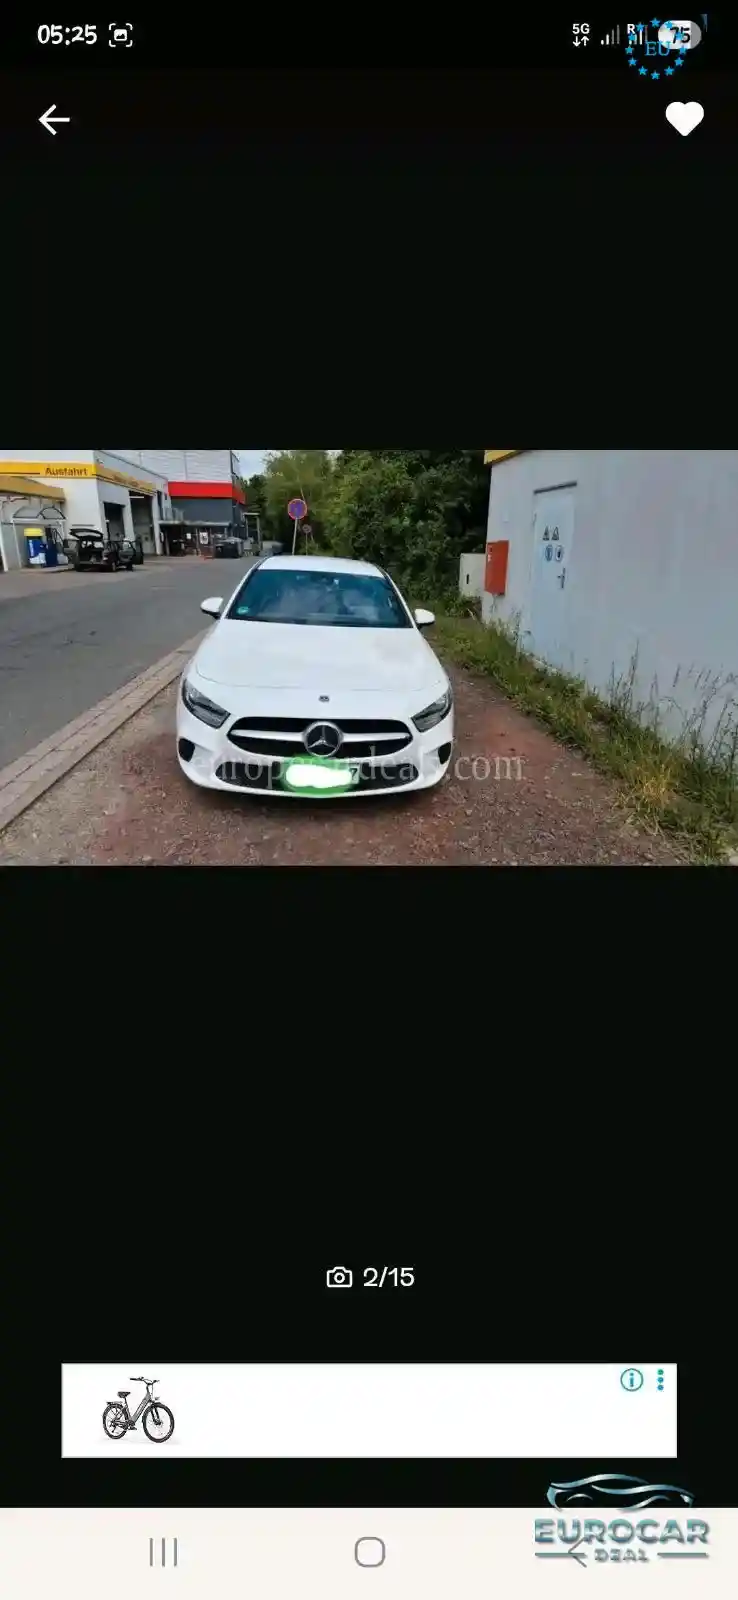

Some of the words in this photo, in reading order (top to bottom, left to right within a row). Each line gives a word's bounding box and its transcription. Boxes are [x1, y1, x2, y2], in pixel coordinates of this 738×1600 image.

[37, 24, 98, 45] 05:25
[572, 23, 590, 34] 5G
[670, 26, 691, 44] 75
[45, 467, 88, 476] Ausfahrt
[363, 1266, 415, 1287] 2/15
